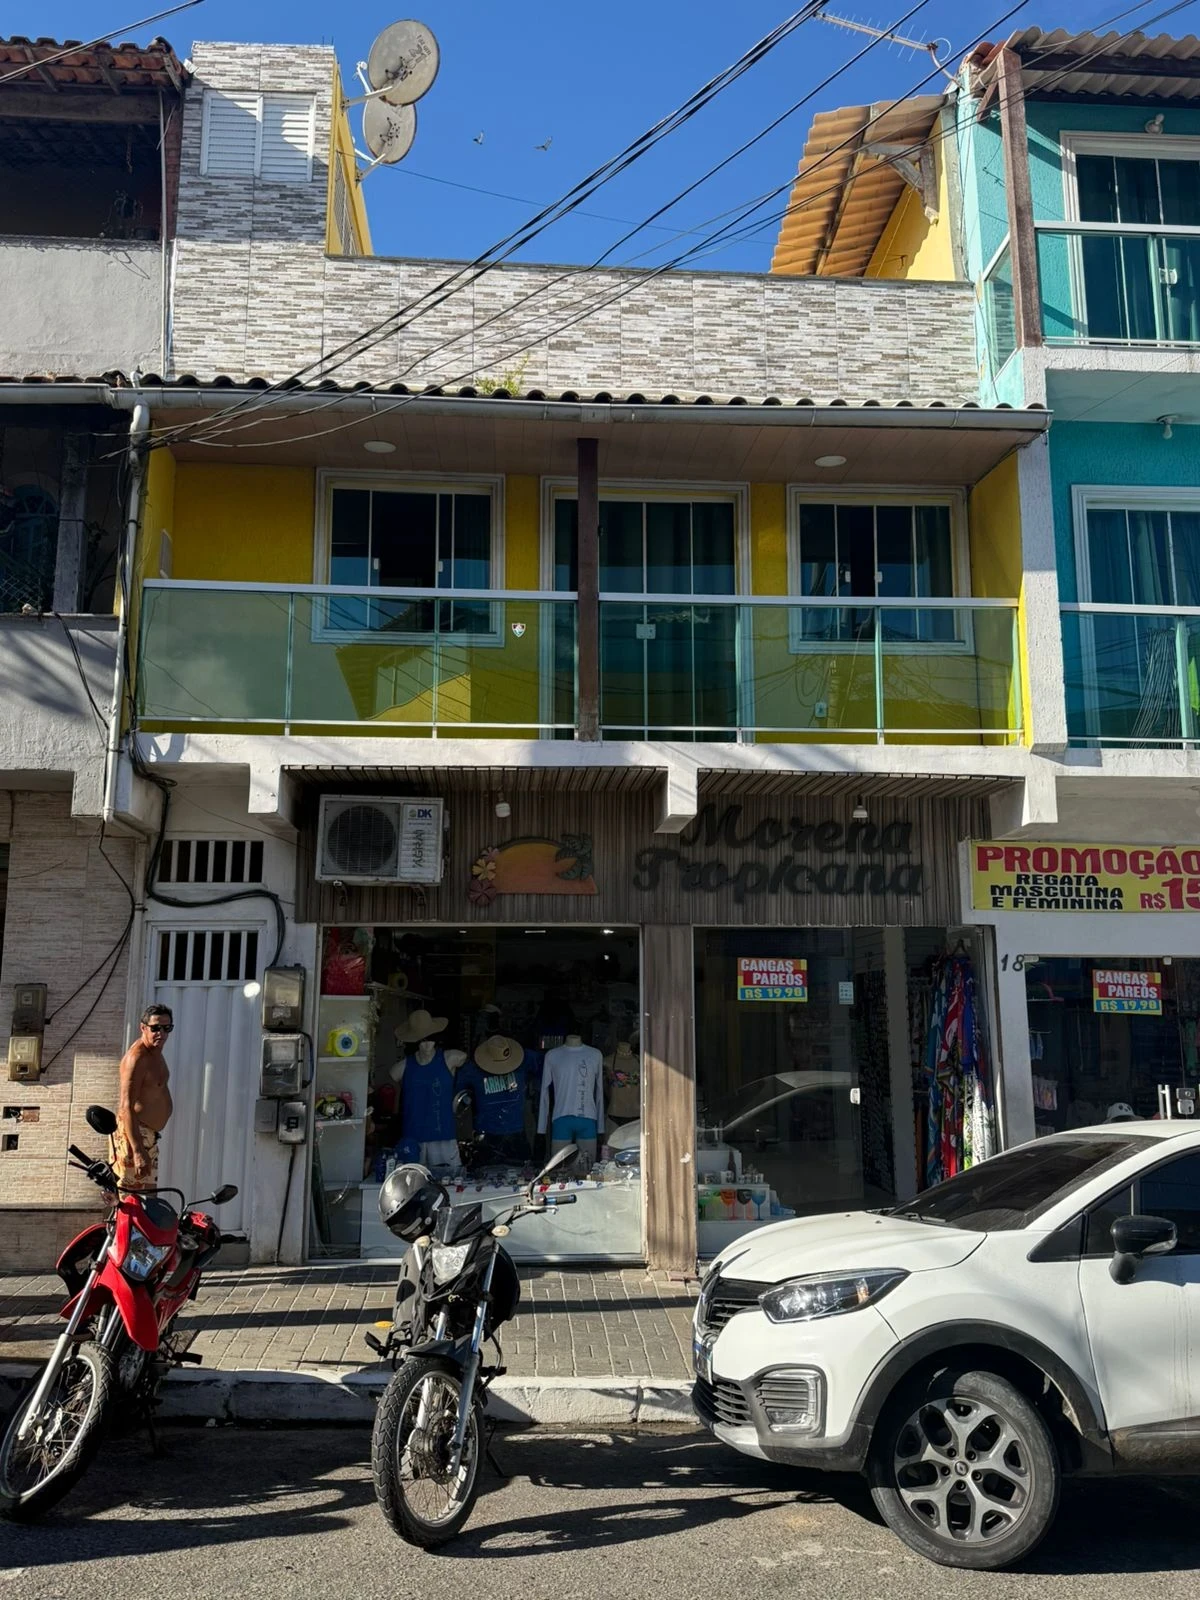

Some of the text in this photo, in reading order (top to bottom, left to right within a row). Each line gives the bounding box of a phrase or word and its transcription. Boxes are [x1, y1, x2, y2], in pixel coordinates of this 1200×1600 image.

[417, 808, 432, 818] DK
[680, 802, 913, 854] Morena
[632, 847, 926, 905] Tropicana
[1016, 873, 1099, 887] REGATA
[990, 885, 1124, 898] MASCULINA
[992, 896, 1123, 910] E FEMININA
[741, 959, 794, 973] CANGAS
[1000, 953, 1024, 972] 18
[1096, 971, 1148, 985] CANGAS
[744, 988, 762, 999] R$
[1100, 1000, 1118, 1012] R$
